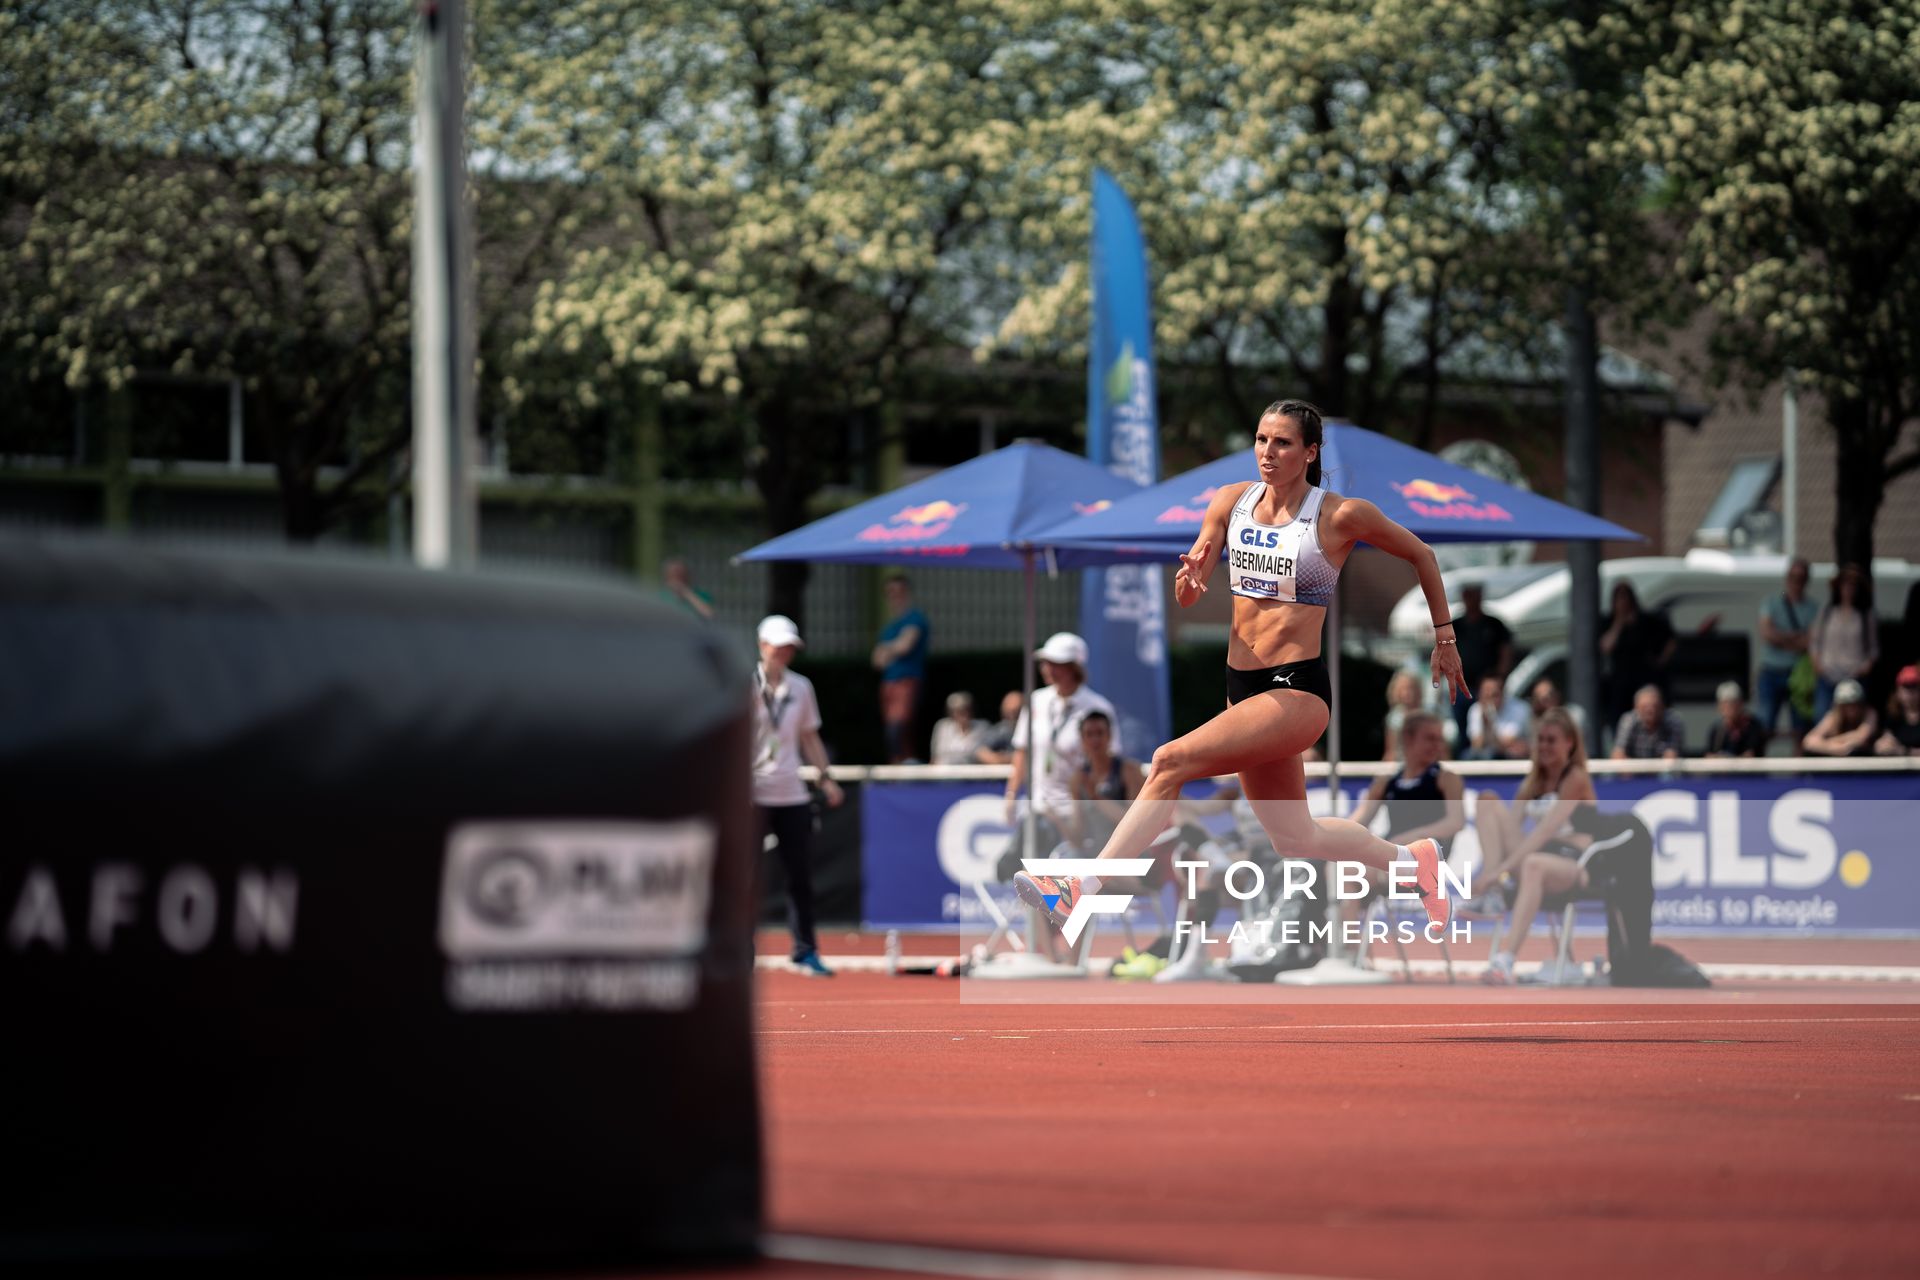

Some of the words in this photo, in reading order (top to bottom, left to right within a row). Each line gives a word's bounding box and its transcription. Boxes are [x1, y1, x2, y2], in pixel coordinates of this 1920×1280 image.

[1231, 548, 1293, 576] OBERMAIER
[1721, 897, 1750, 925] to
[1752, 895, 1838, 928] People
